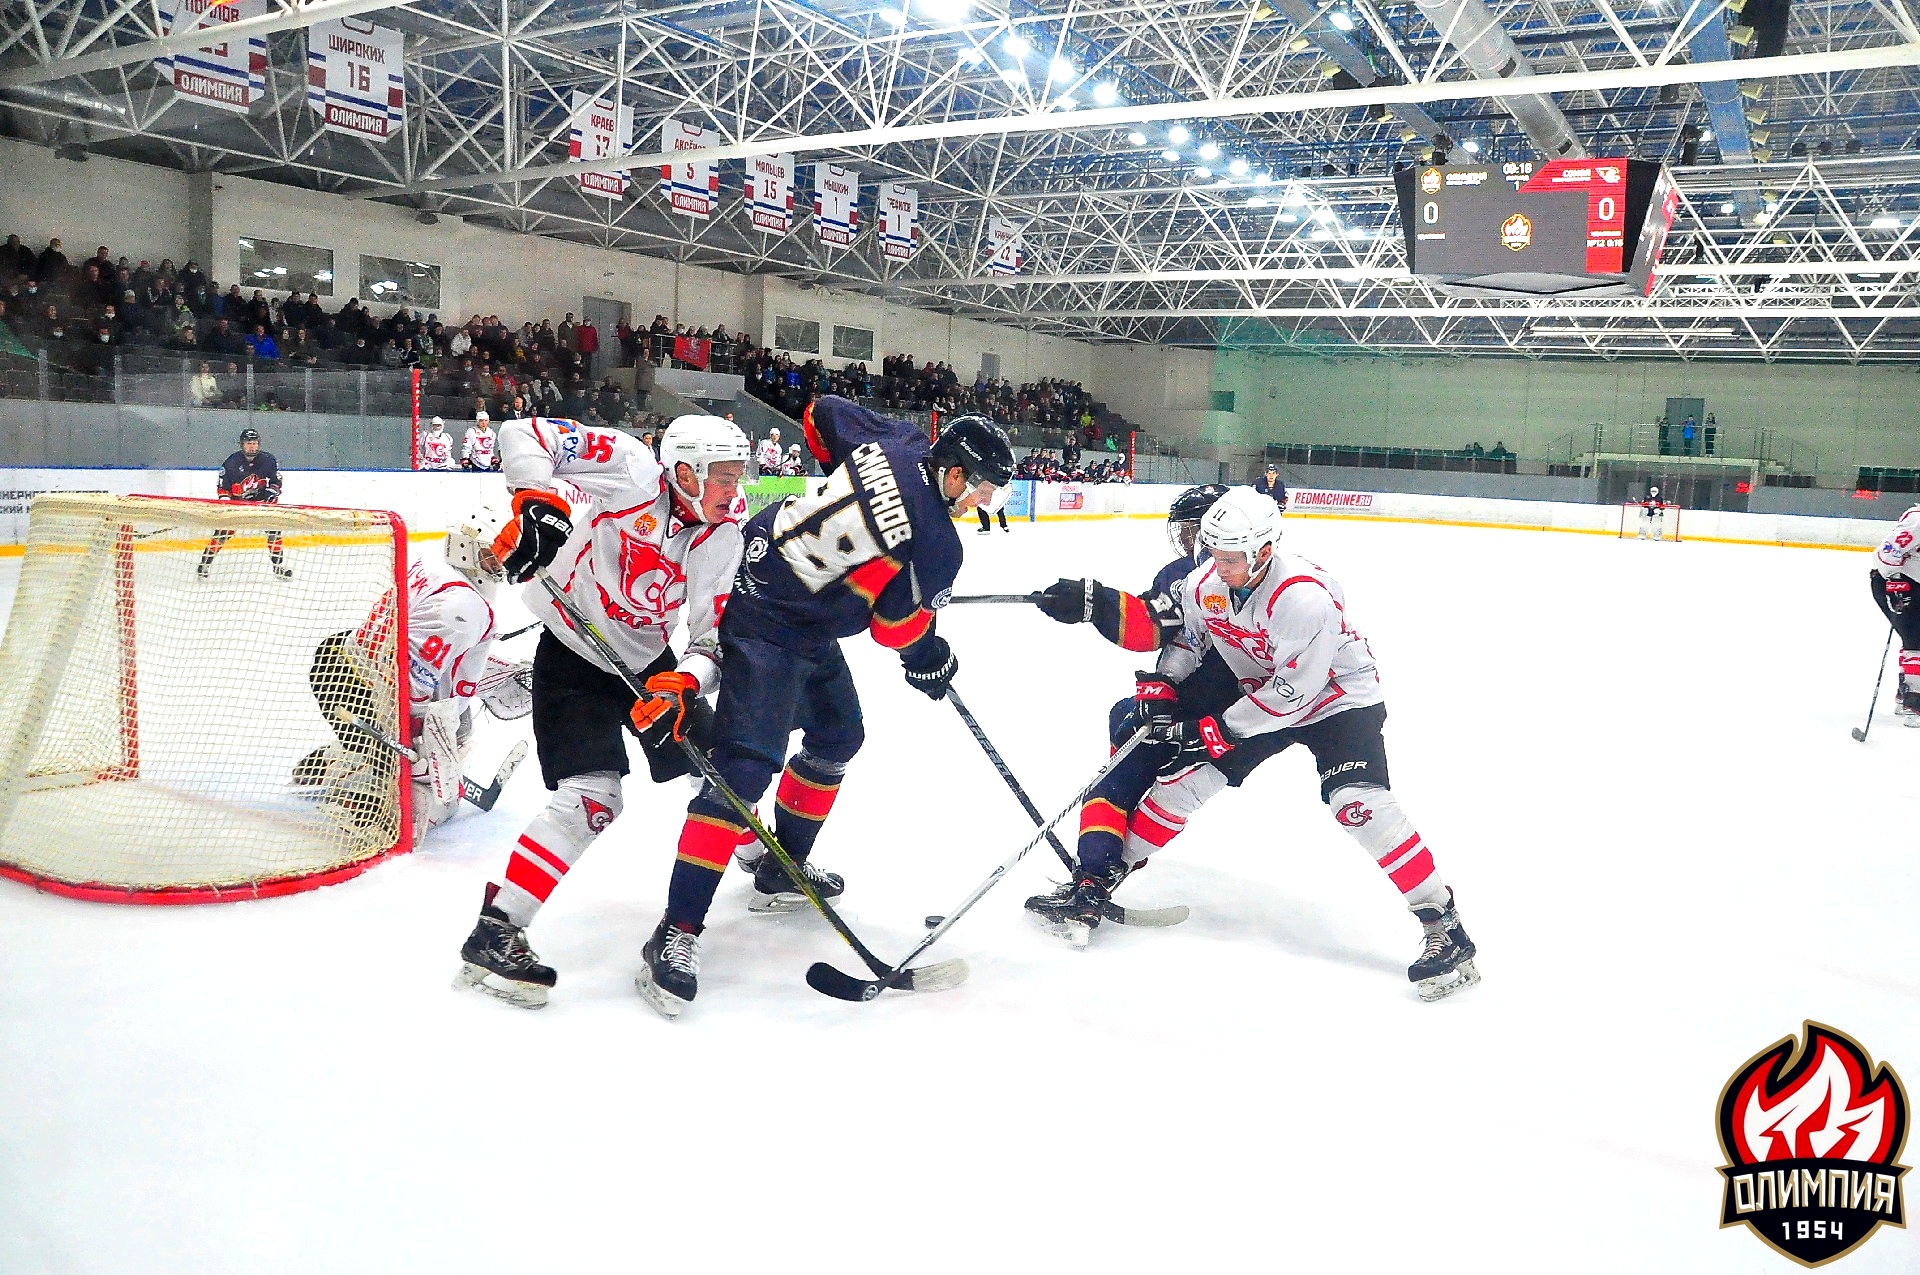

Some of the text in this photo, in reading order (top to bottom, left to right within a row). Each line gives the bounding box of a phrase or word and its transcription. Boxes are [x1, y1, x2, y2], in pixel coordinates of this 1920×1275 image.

[328, 34, 385, 64] ШИРОКИХ
[181, 74, 243, 103] ОЛИМПИЯ
[347, 61, 370, 92] 16
[330, 107, 383, 135] ОЛИМПИЯ
[591, 114, 615, 133] КРАЕВ
[755, 158, 785, 179] МАЛЬЦЕВ
[584, 173, 621, 192] ОЛИМПИЯ
[764, 179, 778, 200] 15
[674, 195, 708, 215] ОЛИМПИЯ
[1422, 201, 1440, 225] 0
[1598, 197, 1615, 221] 0
[852, 442, 912, 550] СМИРНОВ
[1294, 491, 1373, 507] REDMACHINE.RU
[1212, 508, 1228, 522] 11
[420, 635, 452, 671] 91
